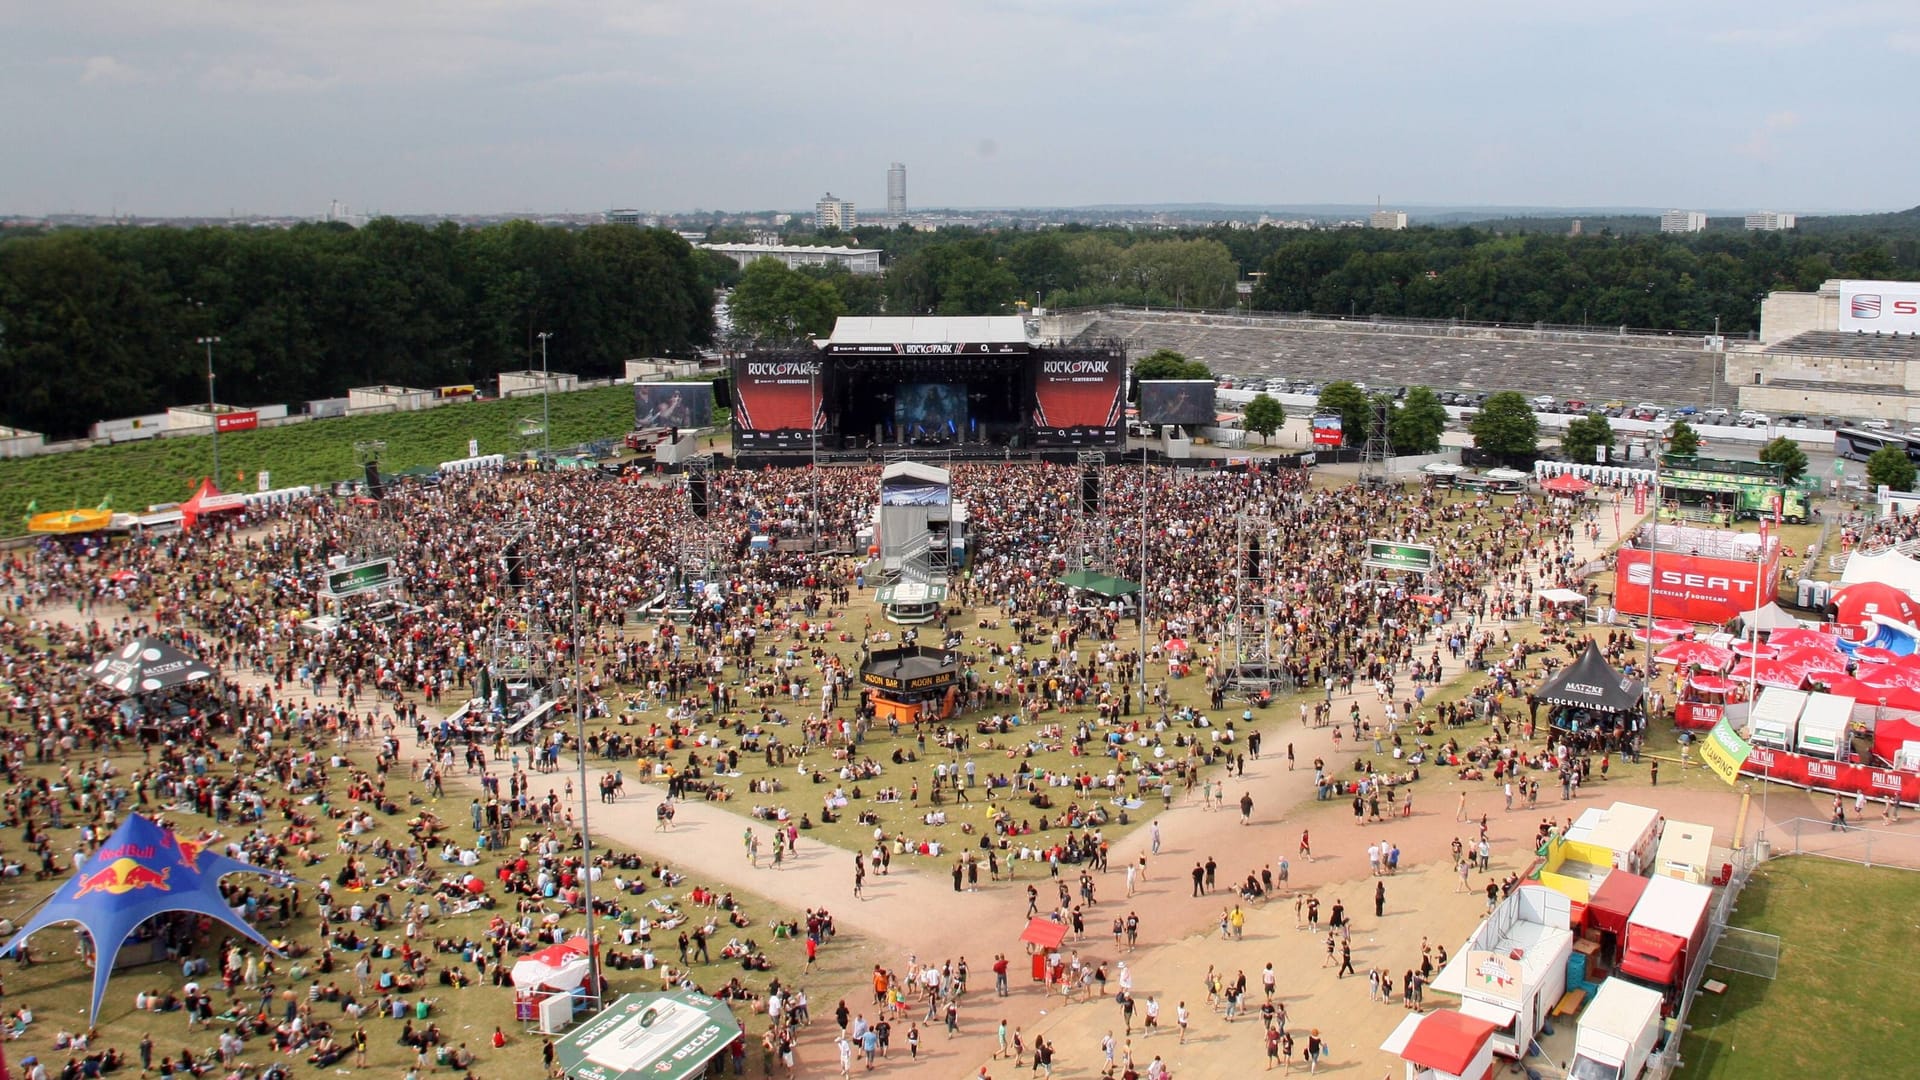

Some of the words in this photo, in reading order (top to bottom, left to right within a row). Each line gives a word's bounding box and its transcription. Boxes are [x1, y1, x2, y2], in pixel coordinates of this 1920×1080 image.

[906, 344, 925, 354] ROCK
[932, 344, 952, 354] PARK
[748, 362, 777, 375] ROCK
[1044, 361, 1071, 374] ROCK
[1081, 361, 1109, 373] PARK
[1661, 571, 1753, 592] SEAT
[1691, 594, 1727, 603] BOOTCAMP
[865, 673, 884, 686] MOON
[886, 678, 898, 688] BAR
[911, 676, 933, 688] MOON
[935, 674, 950, 684] BAR
[1547, 697, 1615, 713] COCKTAILBAR
[99, 842, 125, 861] Red
[127, 843, 155, 858] Bull
[673, 1024, 721, 1060] BECK'S
